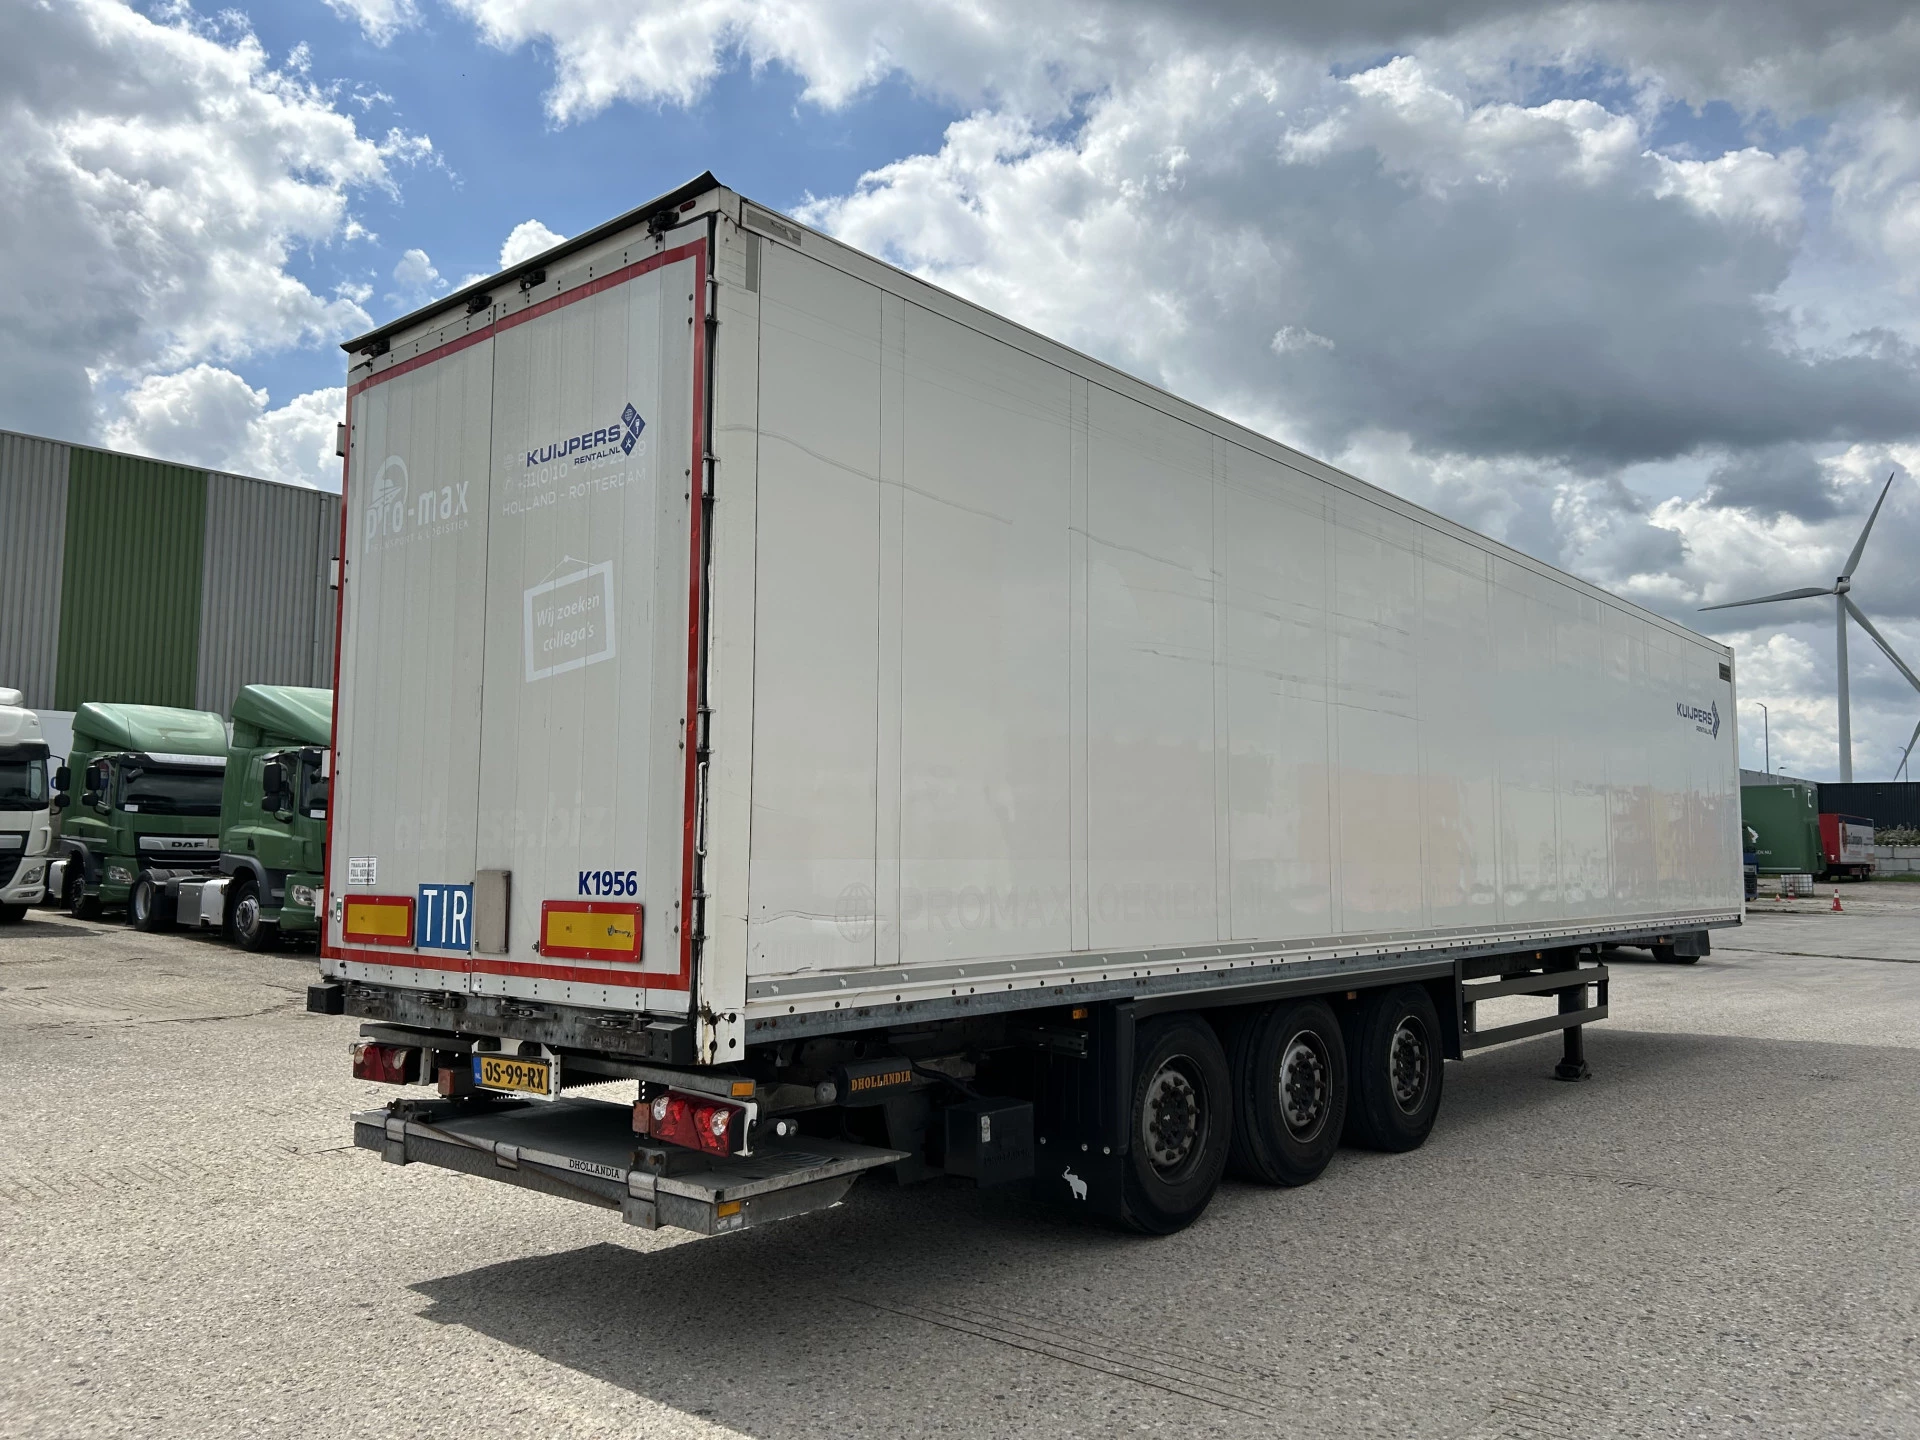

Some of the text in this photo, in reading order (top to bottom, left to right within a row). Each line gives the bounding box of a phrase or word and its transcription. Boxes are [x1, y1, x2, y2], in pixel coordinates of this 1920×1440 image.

[526, 424, 621, 467] KUIJPERS
[574, 446, 620, 465] RENTAL.NL
[502, 491, 556, 516] HOLLAND
[568, 468, 646, 500] ROTTERDAM
[537, 595, 600, 627] Wij zoeken
[543, 621, 594, 651] collega's
[1676, 702, 1712, 725] KUIJPERS
[578, 870, 638, 896] K1956
[423, 889, 468, 945] TIR
[485, 1061, 544, 1089] OS-99-RX
[851, 1070, 911, 1091] DHOLLANDIA
[569, 1159, 620, 1179] DHOLLANDIA
